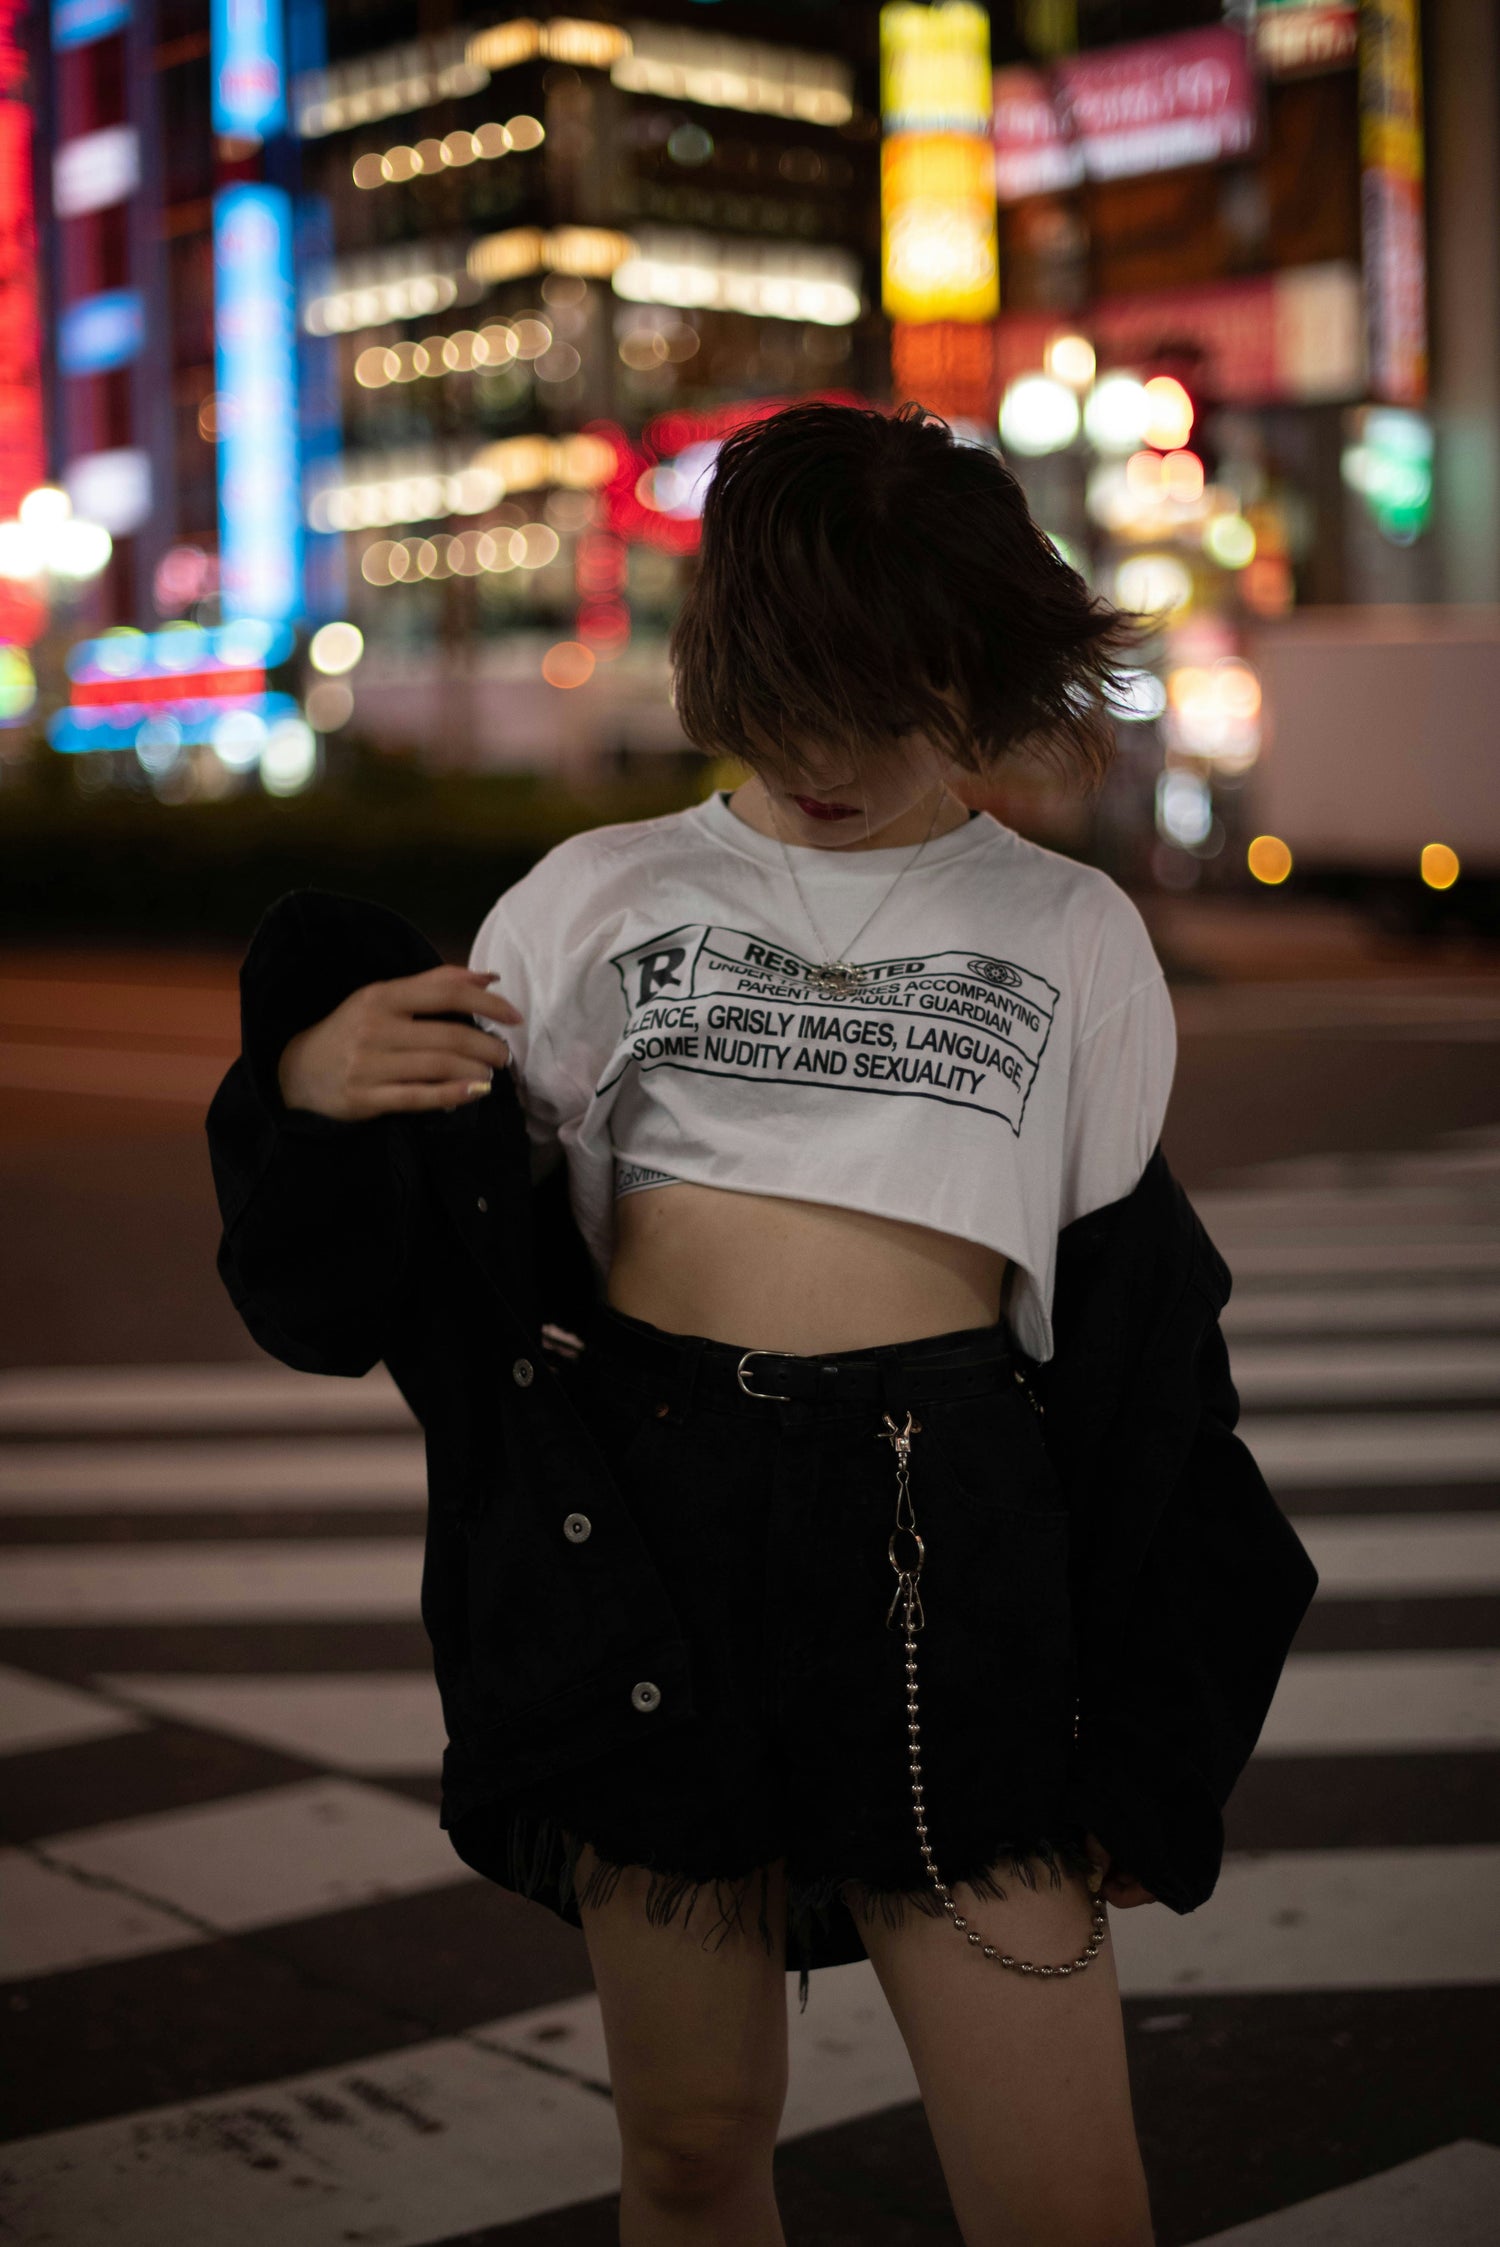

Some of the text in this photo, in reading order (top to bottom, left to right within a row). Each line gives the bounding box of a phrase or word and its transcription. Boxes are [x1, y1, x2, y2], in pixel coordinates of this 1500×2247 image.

[636, 947, 686, 1008] R
[708, 960, 773, 982] UNDER
[904, 979, 1040, 1032] ACCOMPANYING
[737, 979, 811, 1000] PARENT
[850, 993, 916, 1008] ADULT
[919, 994, 1012, 1036] GUARDIAN
[629, 1005, 1023, 1094] LENCE, GRISLY IMAGES, LANGUAGE,
[632, 1036, 986, 1094] SOME NUDITY AND SEXUALITY
